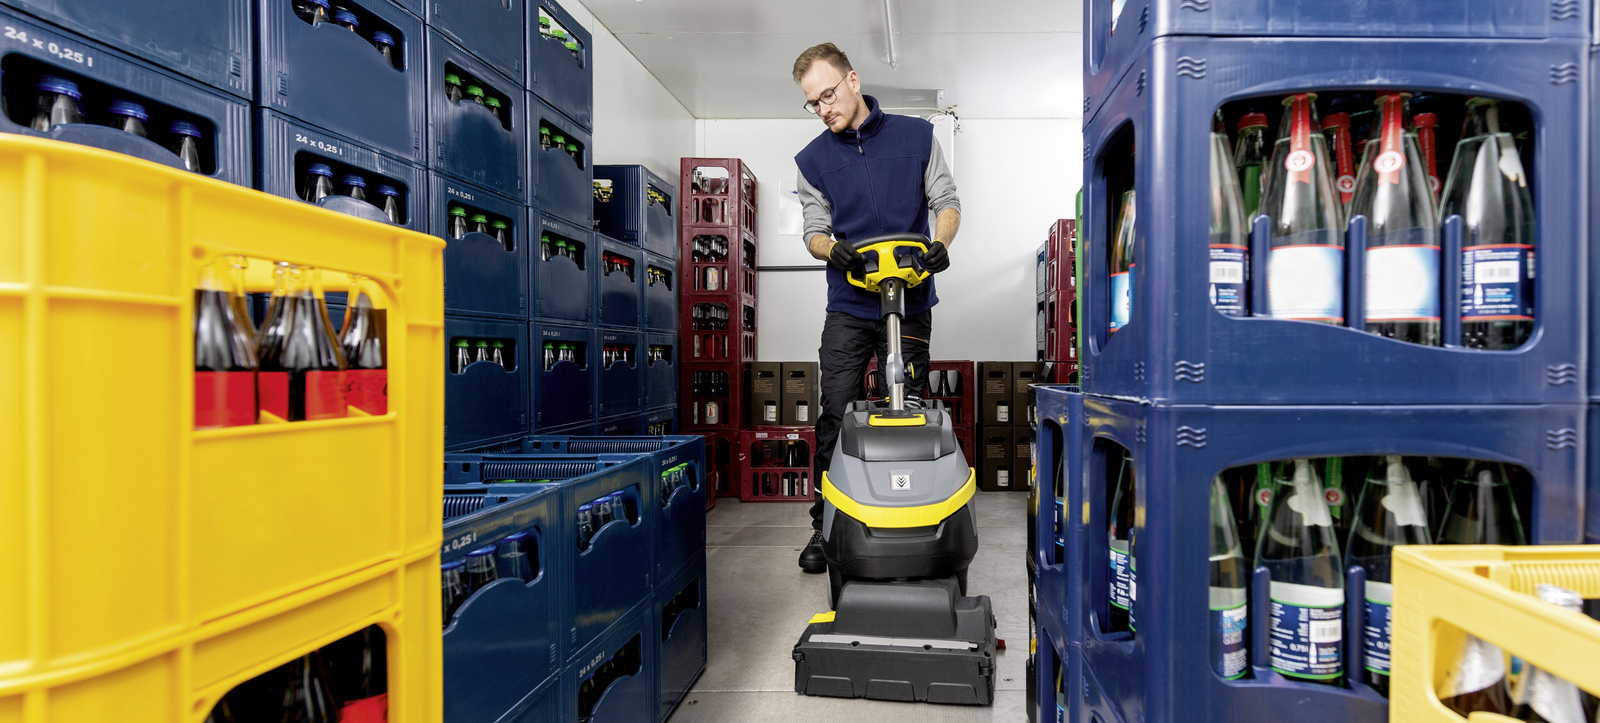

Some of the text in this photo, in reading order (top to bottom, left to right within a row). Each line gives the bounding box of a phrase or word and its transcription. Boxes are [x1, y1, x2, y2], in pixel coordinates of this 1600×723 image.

[4, 26, 28, 43] 24
[32, 38, 44, 49] x
[47, 42, 84, 64] 0,25
[295, 133, 308, 144] 24
[318, 141, 338, 154] 0,25
[447, 186, 455, 195] 24
[460, 191, 471, 200] 0,25
[443, 544, 451, 553] x
[452, 534, 472, 550] 0,25
[579, 666, 586, 678] 24
[591, 653, 602, 667] 0,25
